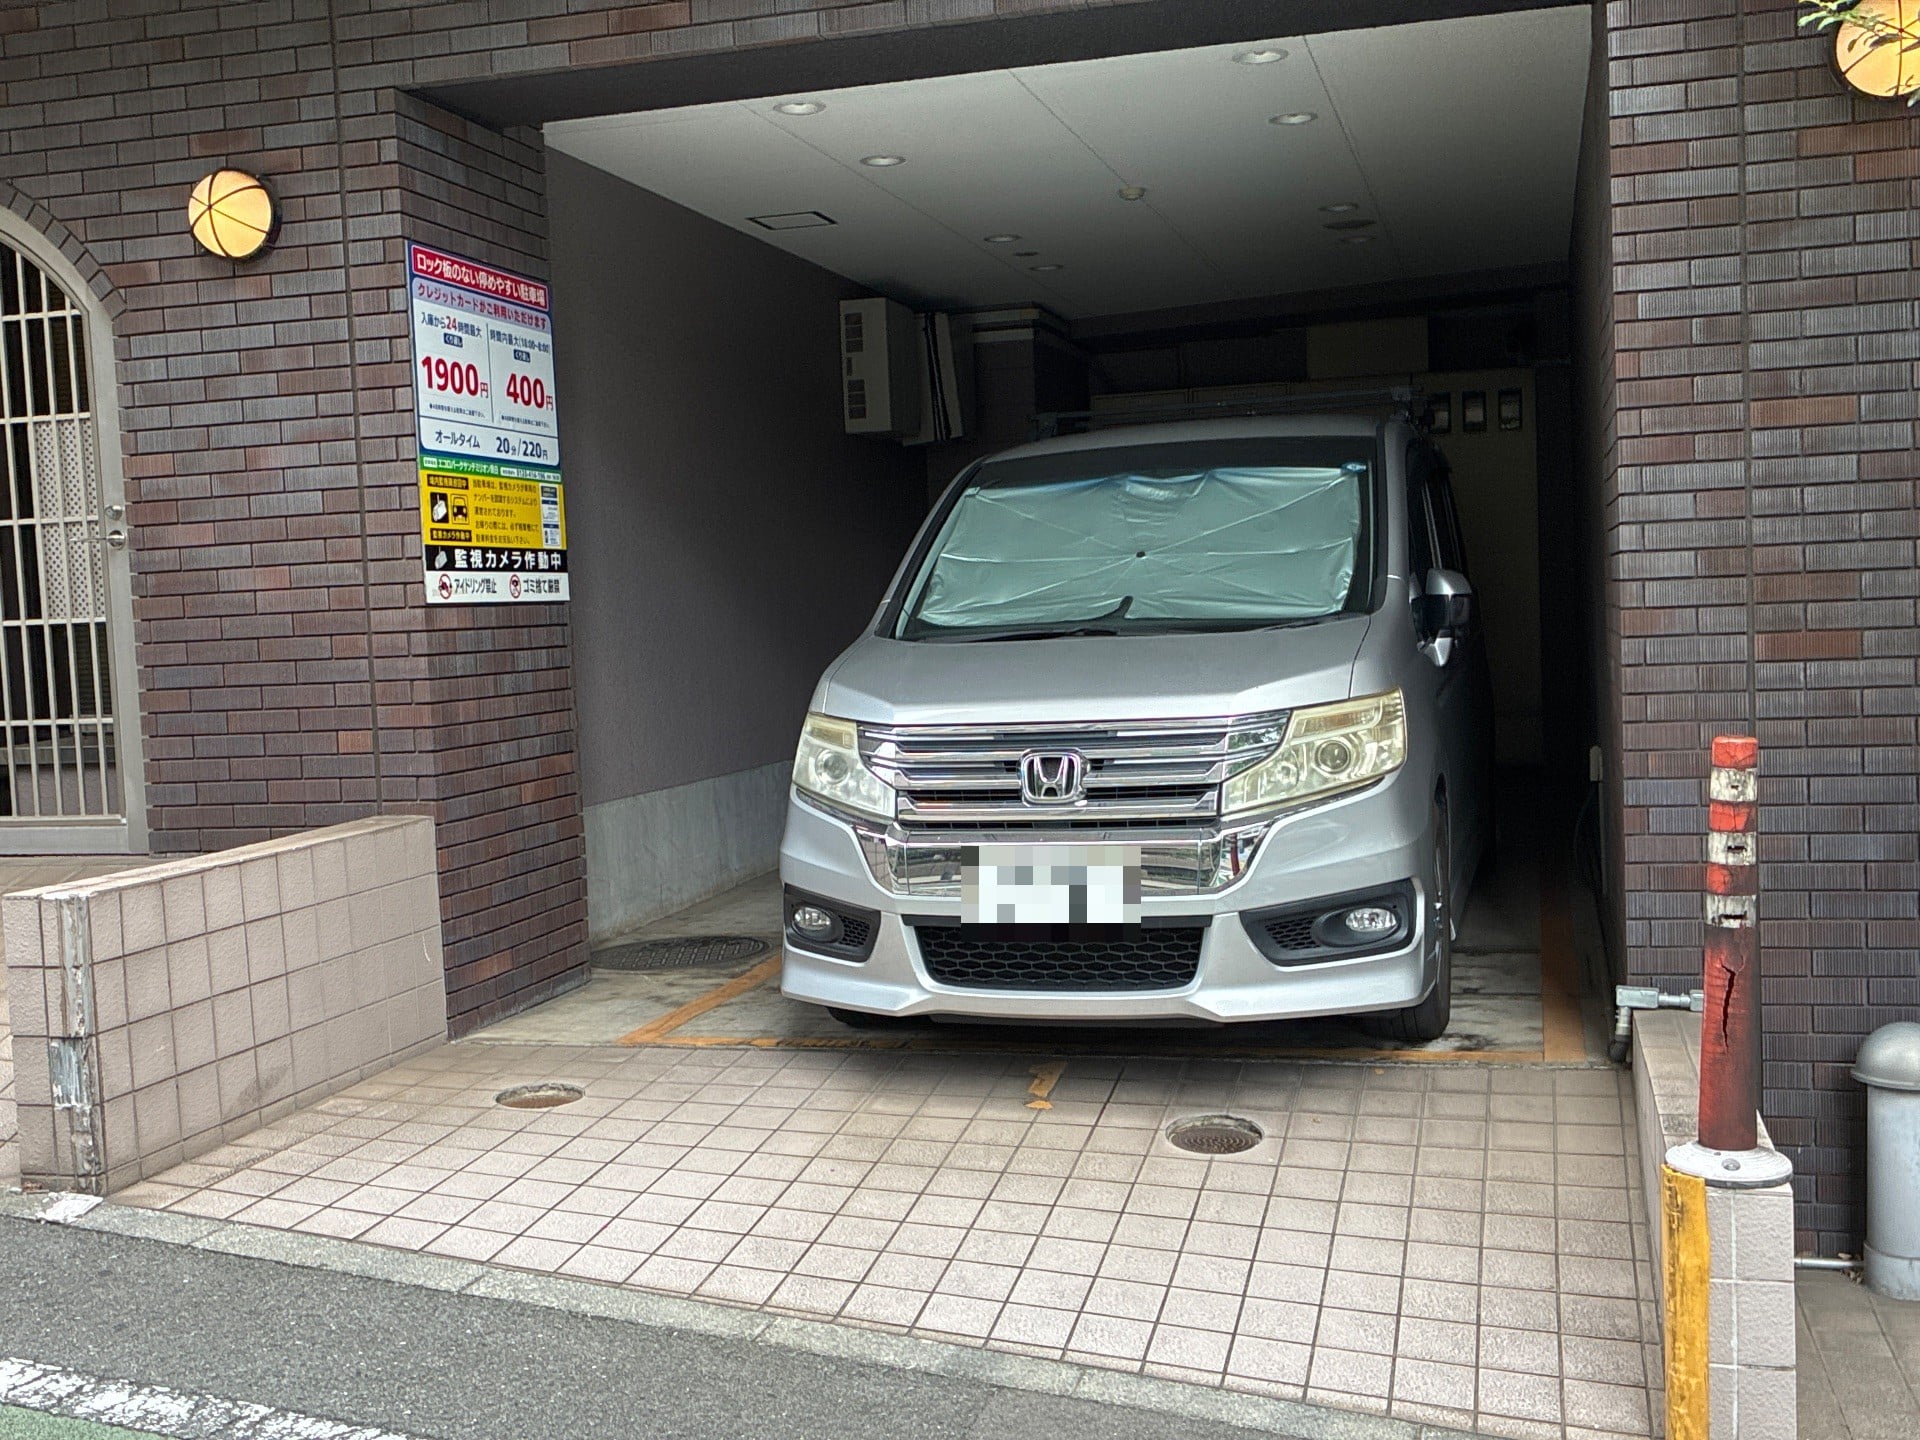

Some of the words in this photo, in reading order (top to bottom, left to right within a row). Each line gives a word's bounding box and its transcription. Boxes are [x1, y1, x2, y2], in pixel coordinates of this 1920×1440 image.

[417, 253, 546, 306] ロック板のない停めやすい駐車場
[418, 283, 547, 329] クレジットカードがご利用いただけます
[435, 430, 480, 449] オールタイム
[454, 548, 562, 570] 監視カメラ作動中
[454, 578, 497, 594] アイドリング禁止
[523, 579, 560, 594] ゴミ捨て厳禁
